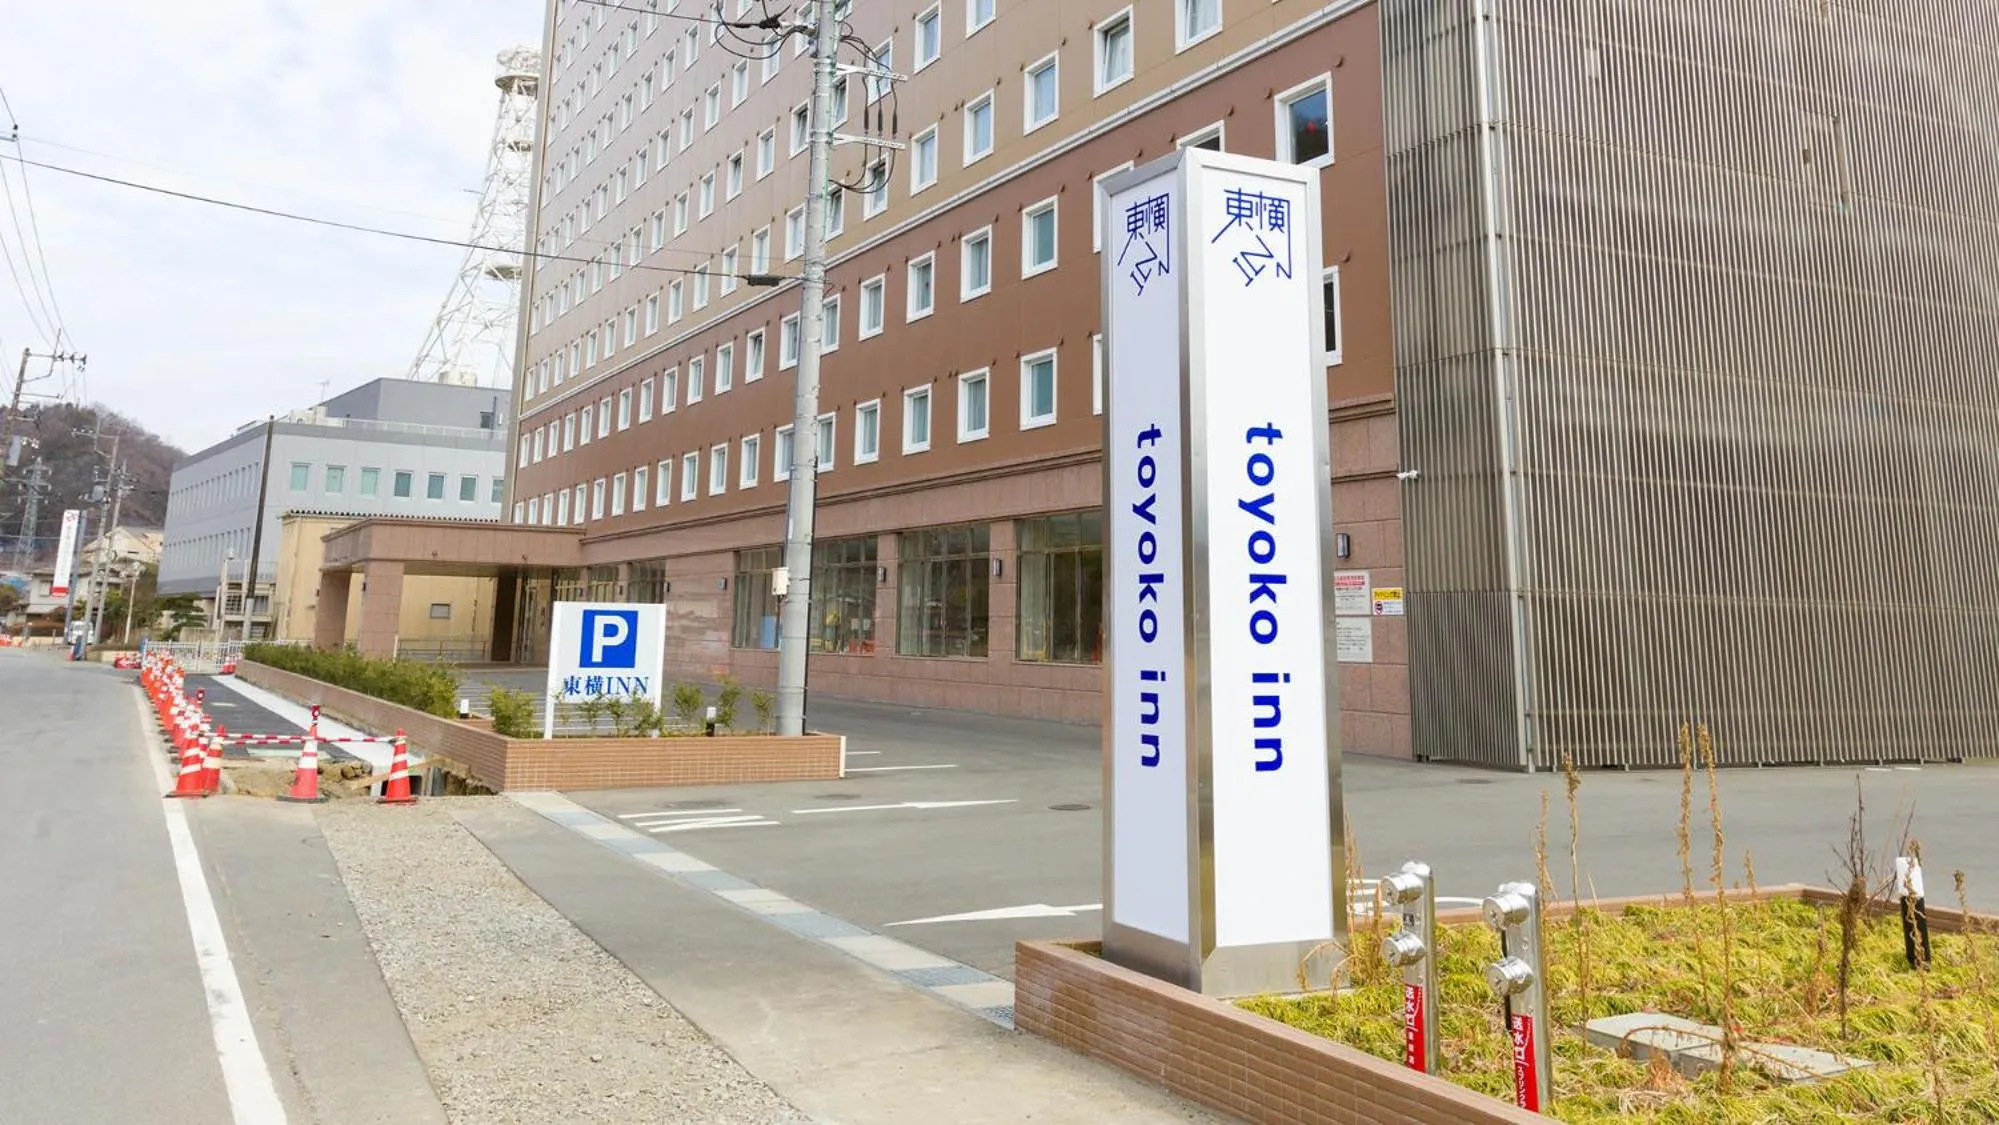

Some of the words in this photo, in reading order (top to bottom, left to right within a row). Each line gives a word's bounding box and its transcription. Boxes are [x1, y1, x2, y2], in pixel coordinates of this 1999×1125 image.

[1132, 423, 1164, 643] toyoko
[1238, 422, 1287, 645] toyoko
[563, 675, 649, 697] 東横INN
[591, 615, 629, 663] P
[1140, 669, 1166, 768] inn
[1251, 672, 1291, 772] inn
